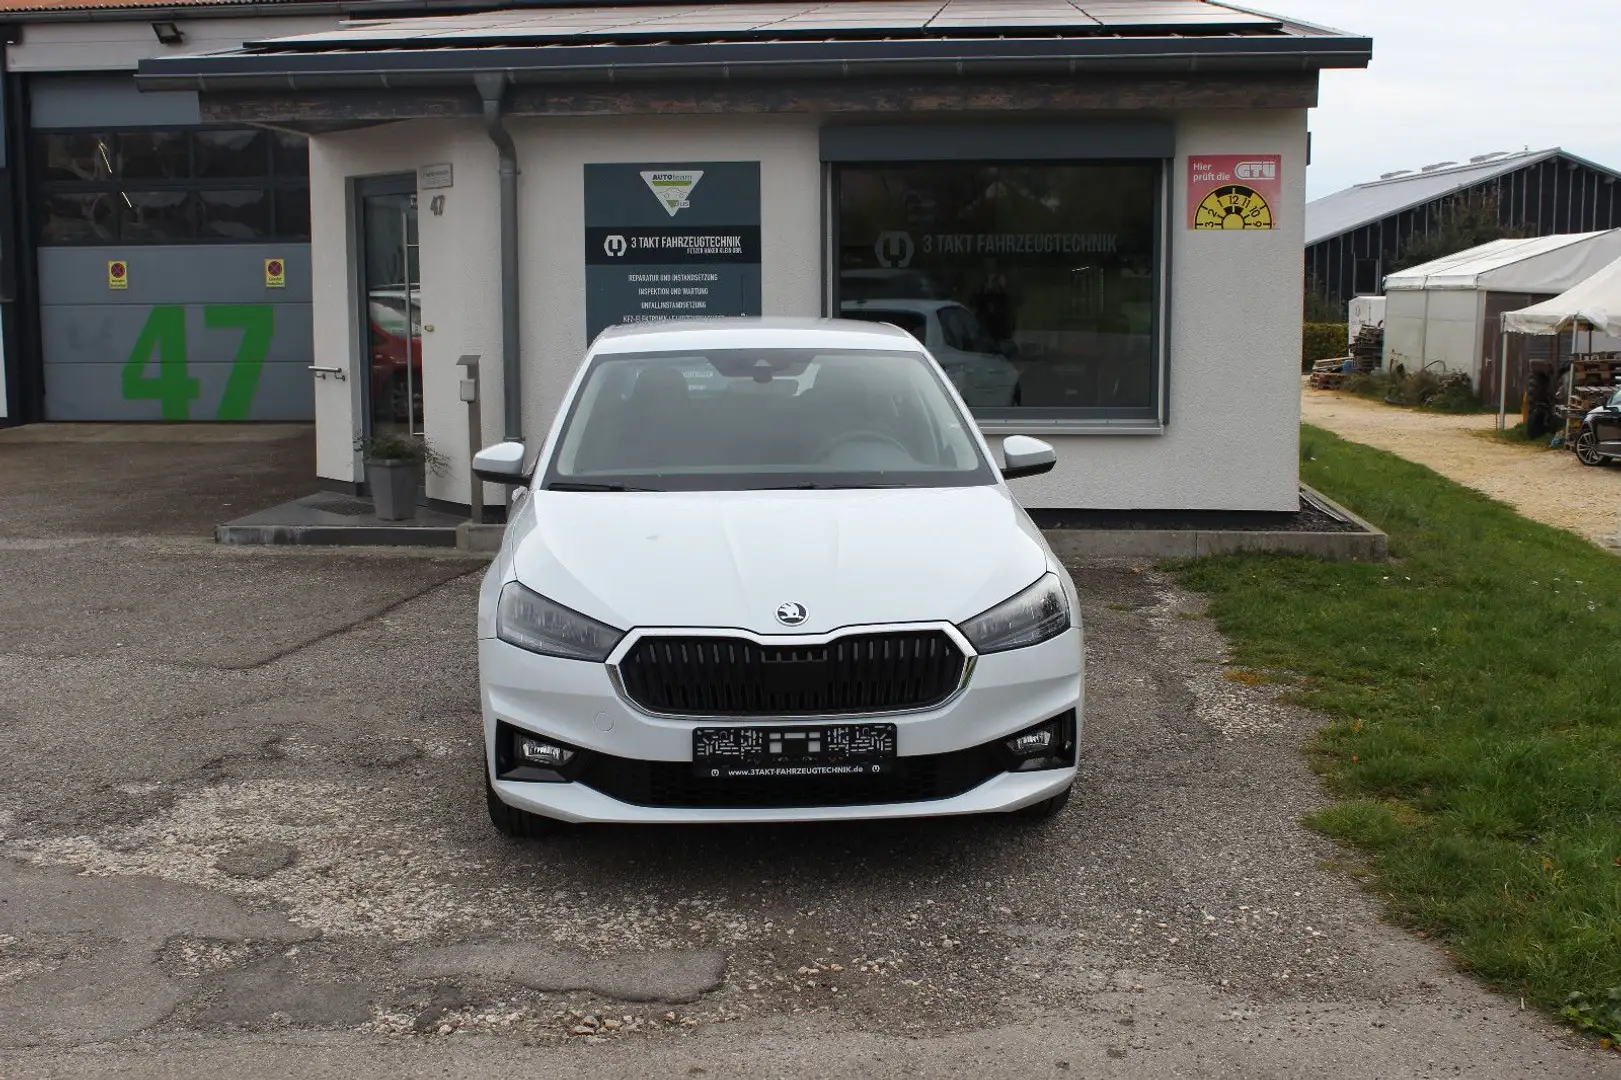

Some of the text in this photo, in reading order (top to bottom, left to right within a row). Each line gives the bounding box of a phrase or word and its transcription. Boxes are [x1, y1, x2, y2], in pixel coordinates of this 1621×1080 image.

[1193, 161, 1212, 171] Hier
[1193, 172, 1230, 183] prüft die
[429, 195, 446, 216] 47
[1228, 195, 1240, 205] 12
[631, 235, 742, 249] 3 TAKT FAHRZEUGTECHNIK
[922, 233, 1118, 253] 3 TAKT FAHRZEUGTECHNIK
[628, 274, 659, 282] REPARATUR
[638, 287, 669, 295] INSPEKTION
[670, 287, 681, 295] UND
[121, 304, 274, 420] 47
